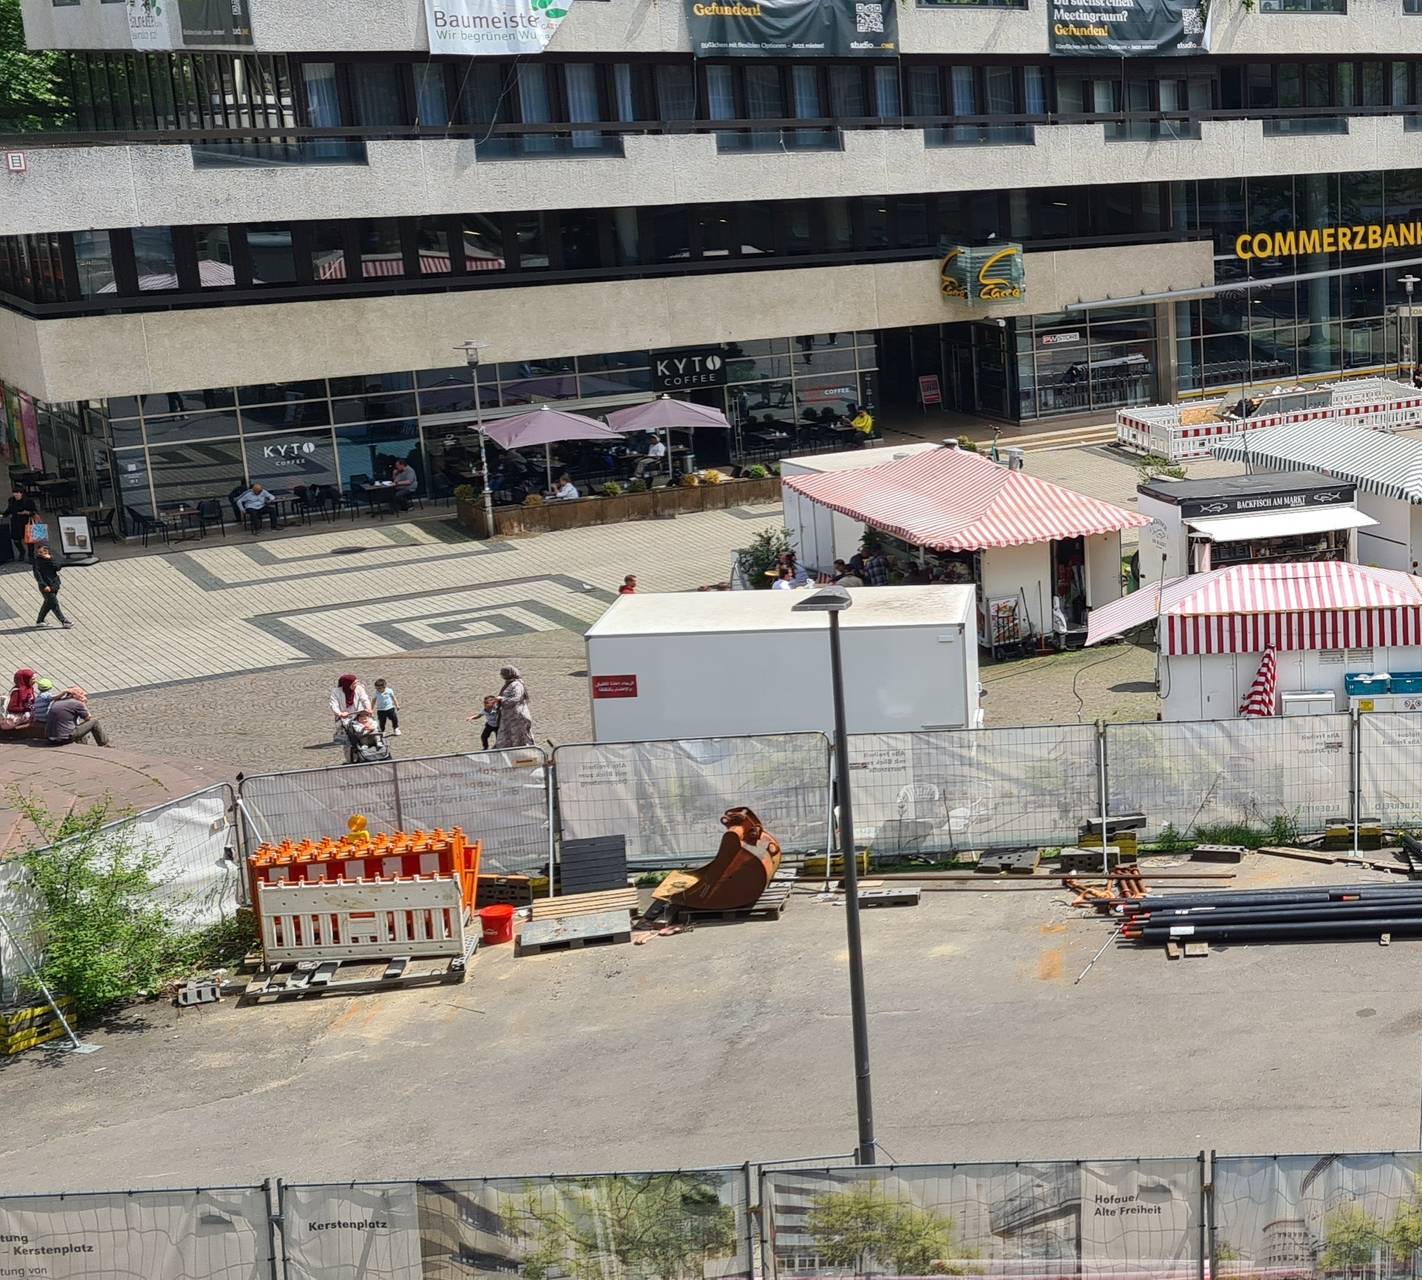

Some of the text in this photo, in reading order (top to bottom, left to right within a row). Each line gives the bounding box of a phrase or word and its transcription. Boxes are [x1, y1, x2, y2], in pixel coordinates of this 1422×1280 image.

[693, 4, 761, 16] Gefunden!
[1054, 9, 1128, 22] Meetingraum?
[436, 30, 516, 43] Wir begrünen
[1055, 25, 1109, 36] Gefunden!
[664, 373, 716, 386] COFFEE
[824, 387, 849, 395] COFFEE
[1236, 494, 1306, 509] BACKFISCH AM MARKT
[1093, 1204, 1162, 1217] Alte Freiheit
[308, 1219, 388, 1231] Kerstenplatz
[13, 1243, 94, 1256] Kerstenplatz
[28, 1266, 47, 1274] von
